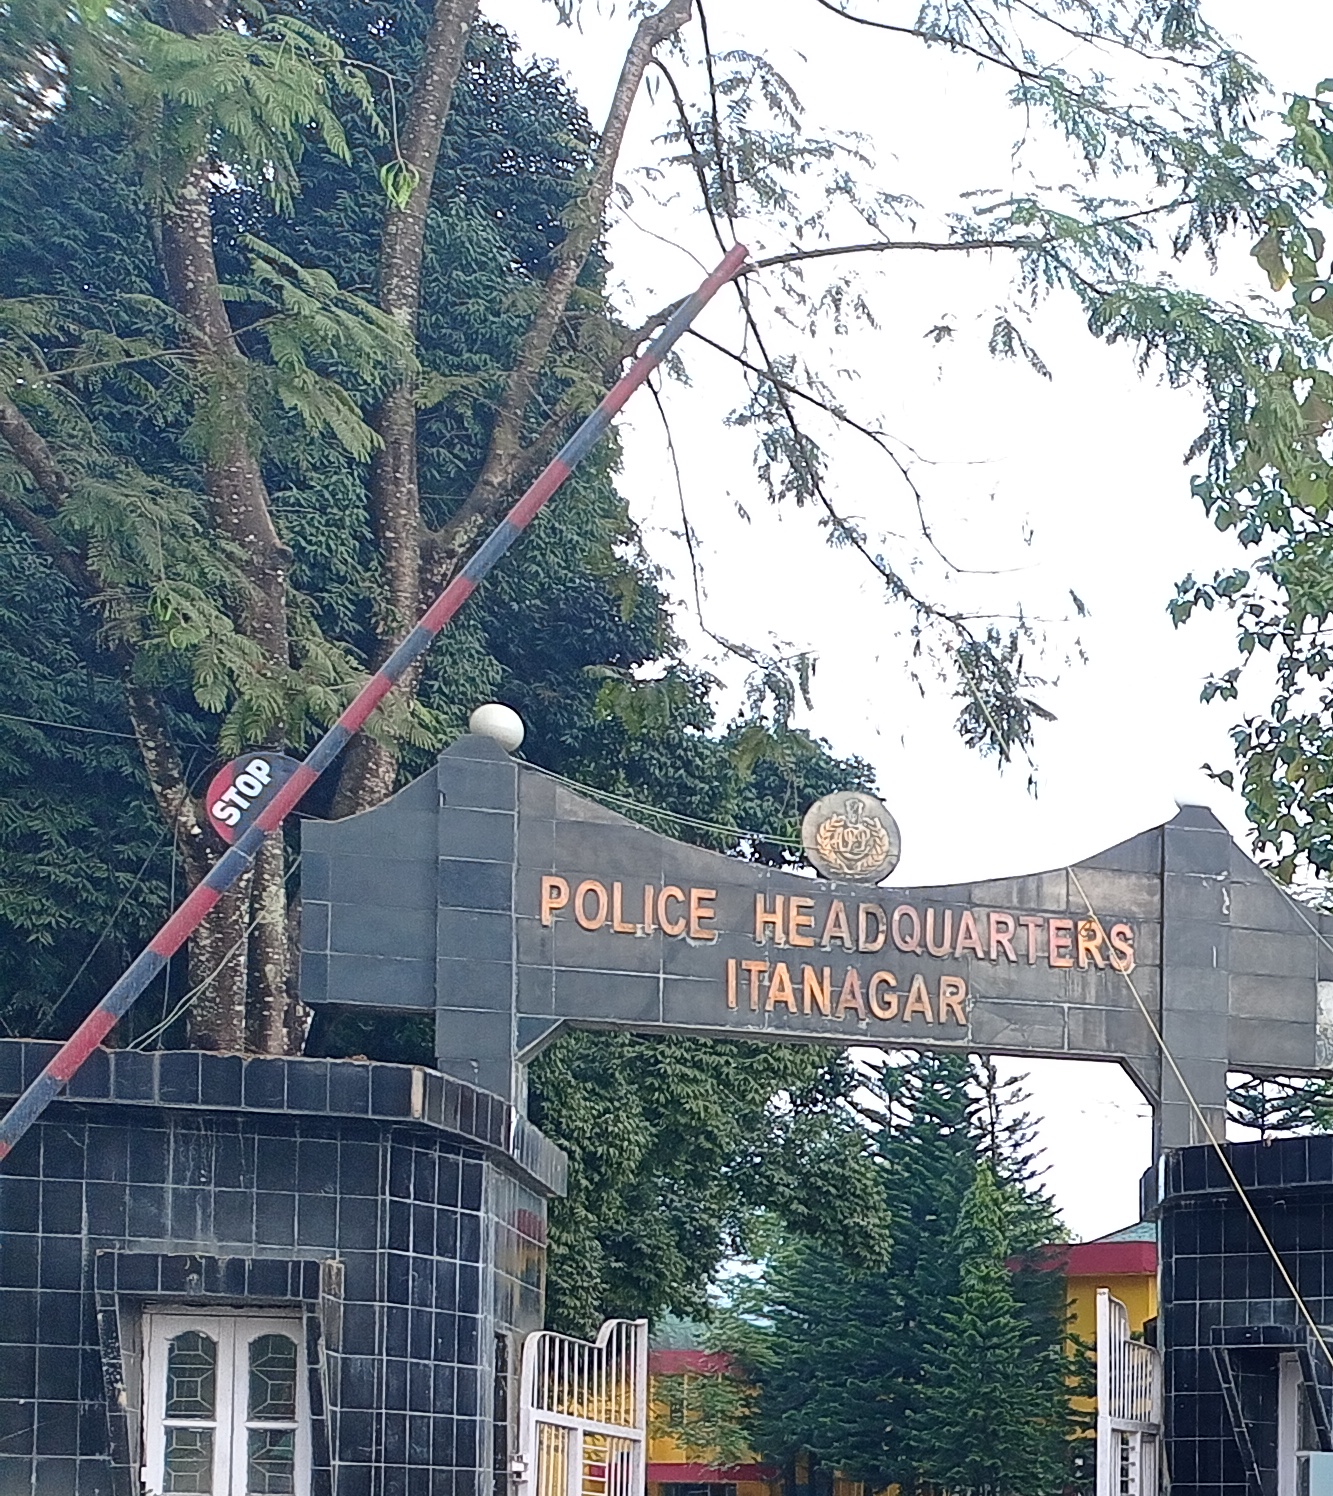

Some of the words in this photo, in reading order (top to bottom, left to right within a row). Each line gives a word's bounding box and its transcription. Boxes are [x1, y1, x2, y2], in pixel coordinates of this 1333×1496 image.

[212, 759, 272, 826] STOP
[540, 875, 718, 941] POLICE
[755, 892, 1135, 974] HEADQUARTERS
[727, 958, 968, 1026] ITANAGAR
